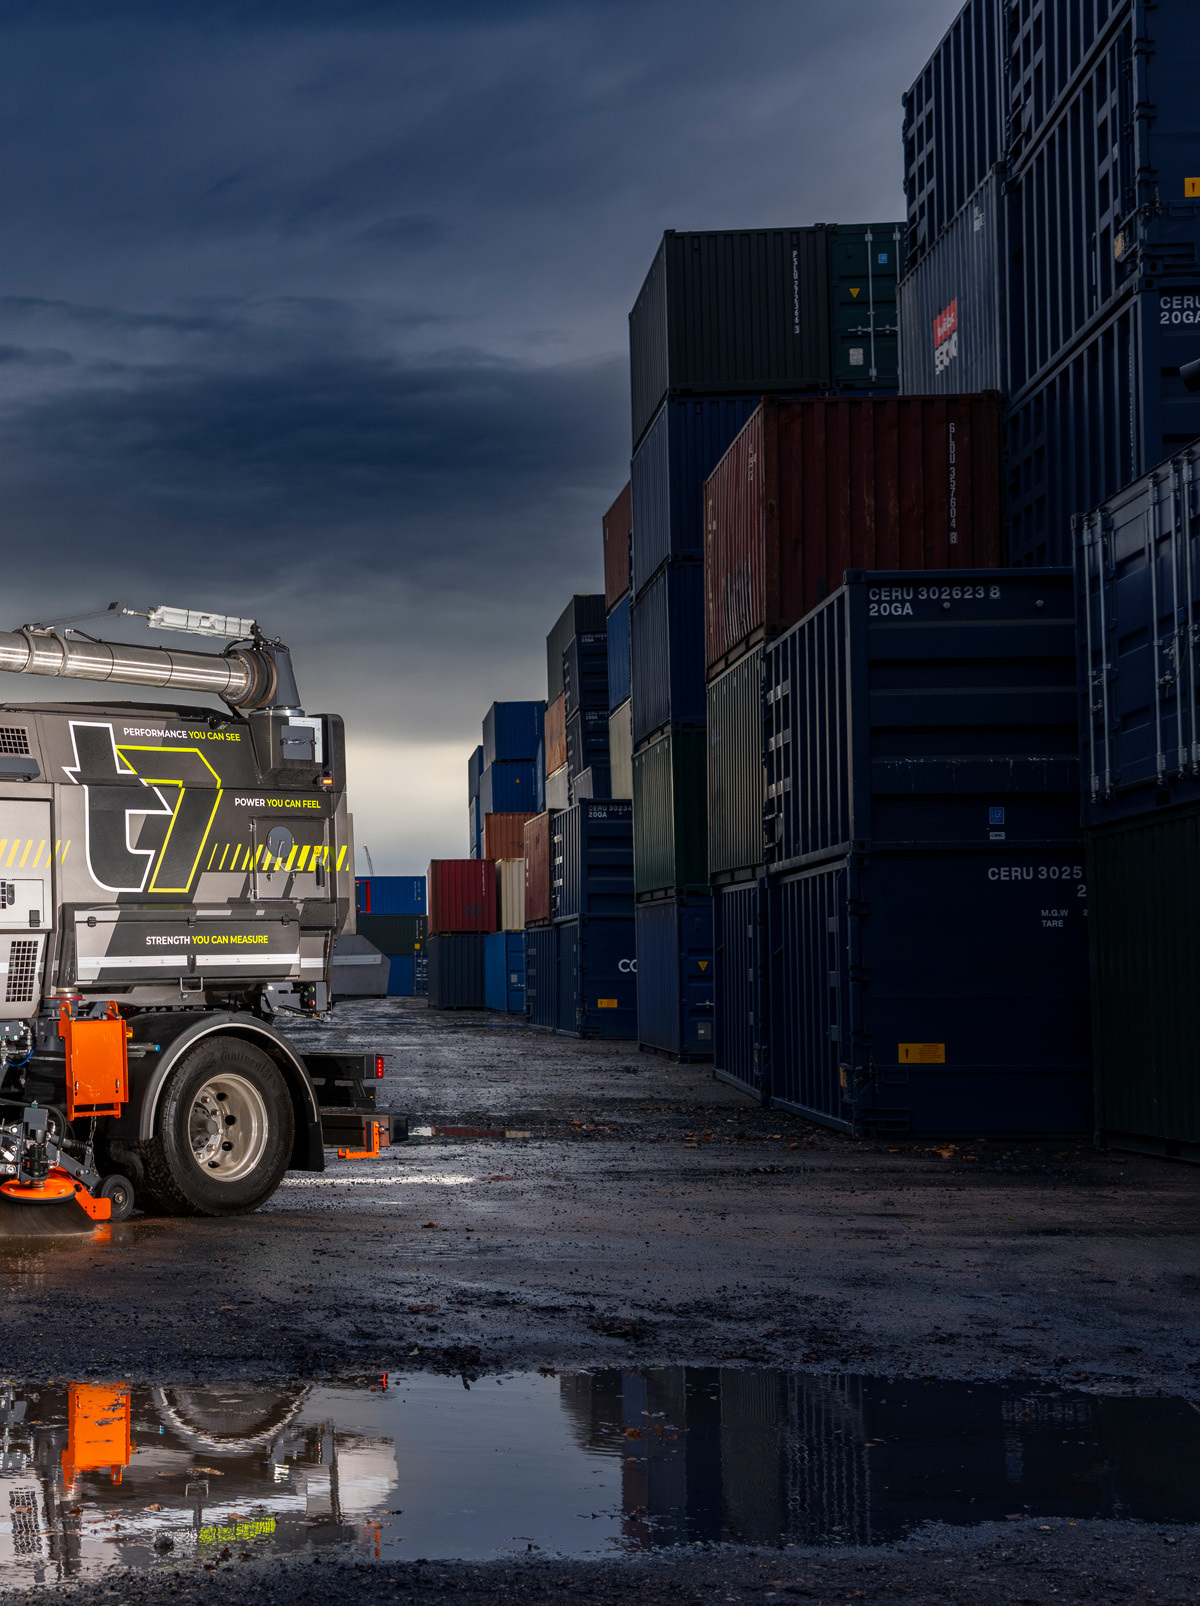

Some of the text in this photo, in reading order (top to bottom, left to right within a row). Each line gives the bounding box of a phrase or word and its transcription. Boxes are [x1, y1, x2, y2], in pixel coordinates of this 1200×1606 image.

[949, 532, 958, 544] 8
[869, 585, 1000, 600] CERU 302623 8
[869, 602, 913, 616] 20GA
[123, 727, 241, 741] PERFORMANCE YOU CAN SEE
[235, 798, 321, 808] POWER YOU CAN FEEL
[987, 866, 1034, 880] CERU
[1041, 909, 1069, 917] M.G.W
[1042, 920, 1064, 928] TARE
[145, 935, 268, 945] STRENGTH YOU CAN MEASURE
